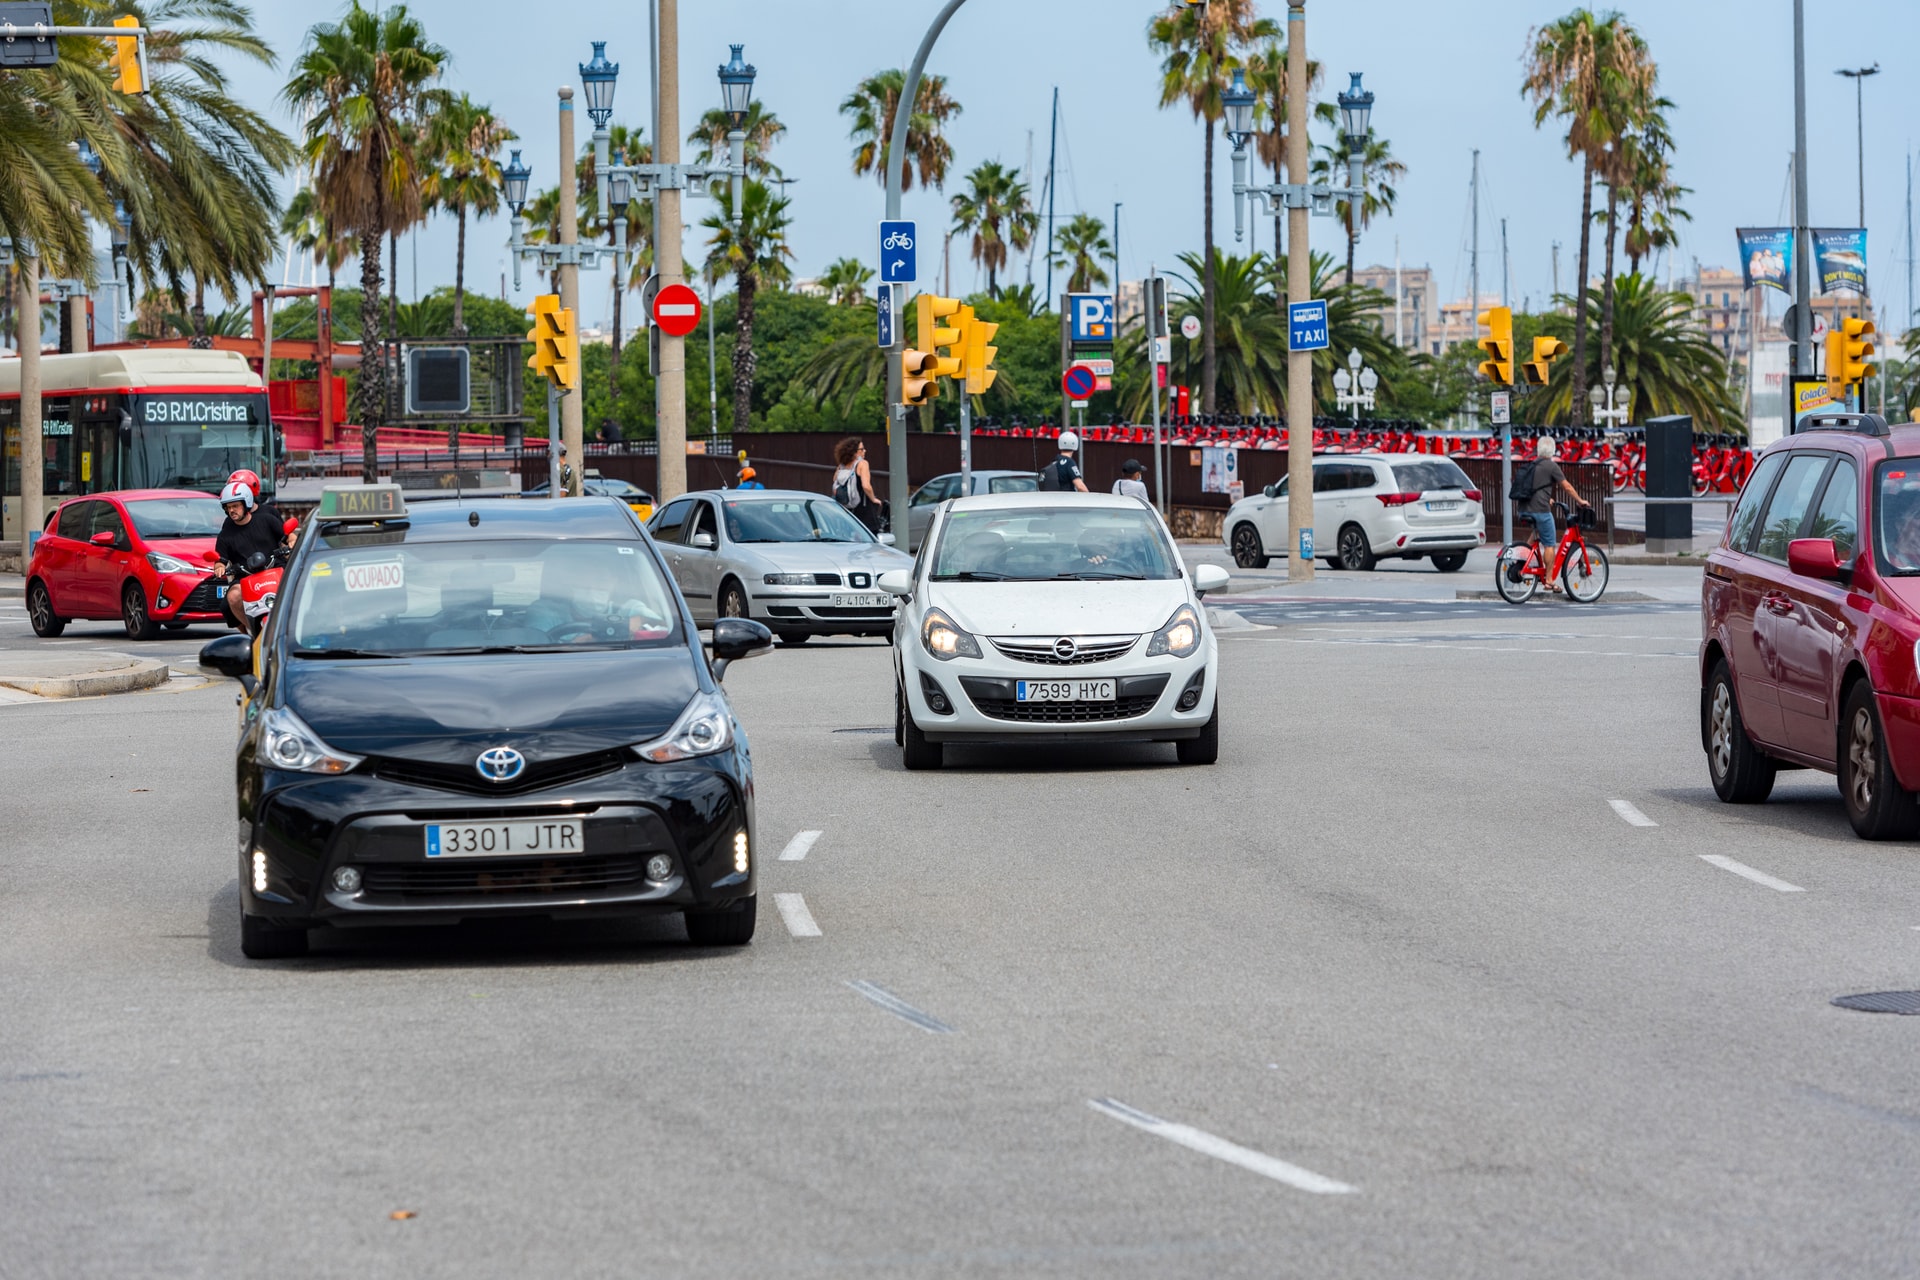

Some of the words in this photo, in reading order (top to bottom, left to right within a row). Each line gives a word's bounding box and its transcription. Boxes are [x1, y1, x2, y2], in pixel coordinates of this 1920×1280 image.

[1079, 299, 1105, 336] P
[1294, 328, 1325, 344] TAXI
[1800, 385, 1829, 402] ColaCa
[145, 401, 168, 422] 59
[170, 401, 247, 422] R.M.Cristina
[340, 491, 375, 512] TAXI
[347, 565, 401, 589] OCUPADO
[1029, 683, 1071, 699] 7599
[1079, 682, 1110, 699] HYC
[445, 827, 510, 852] 3301
[526, 824, 575, 849] JTR
